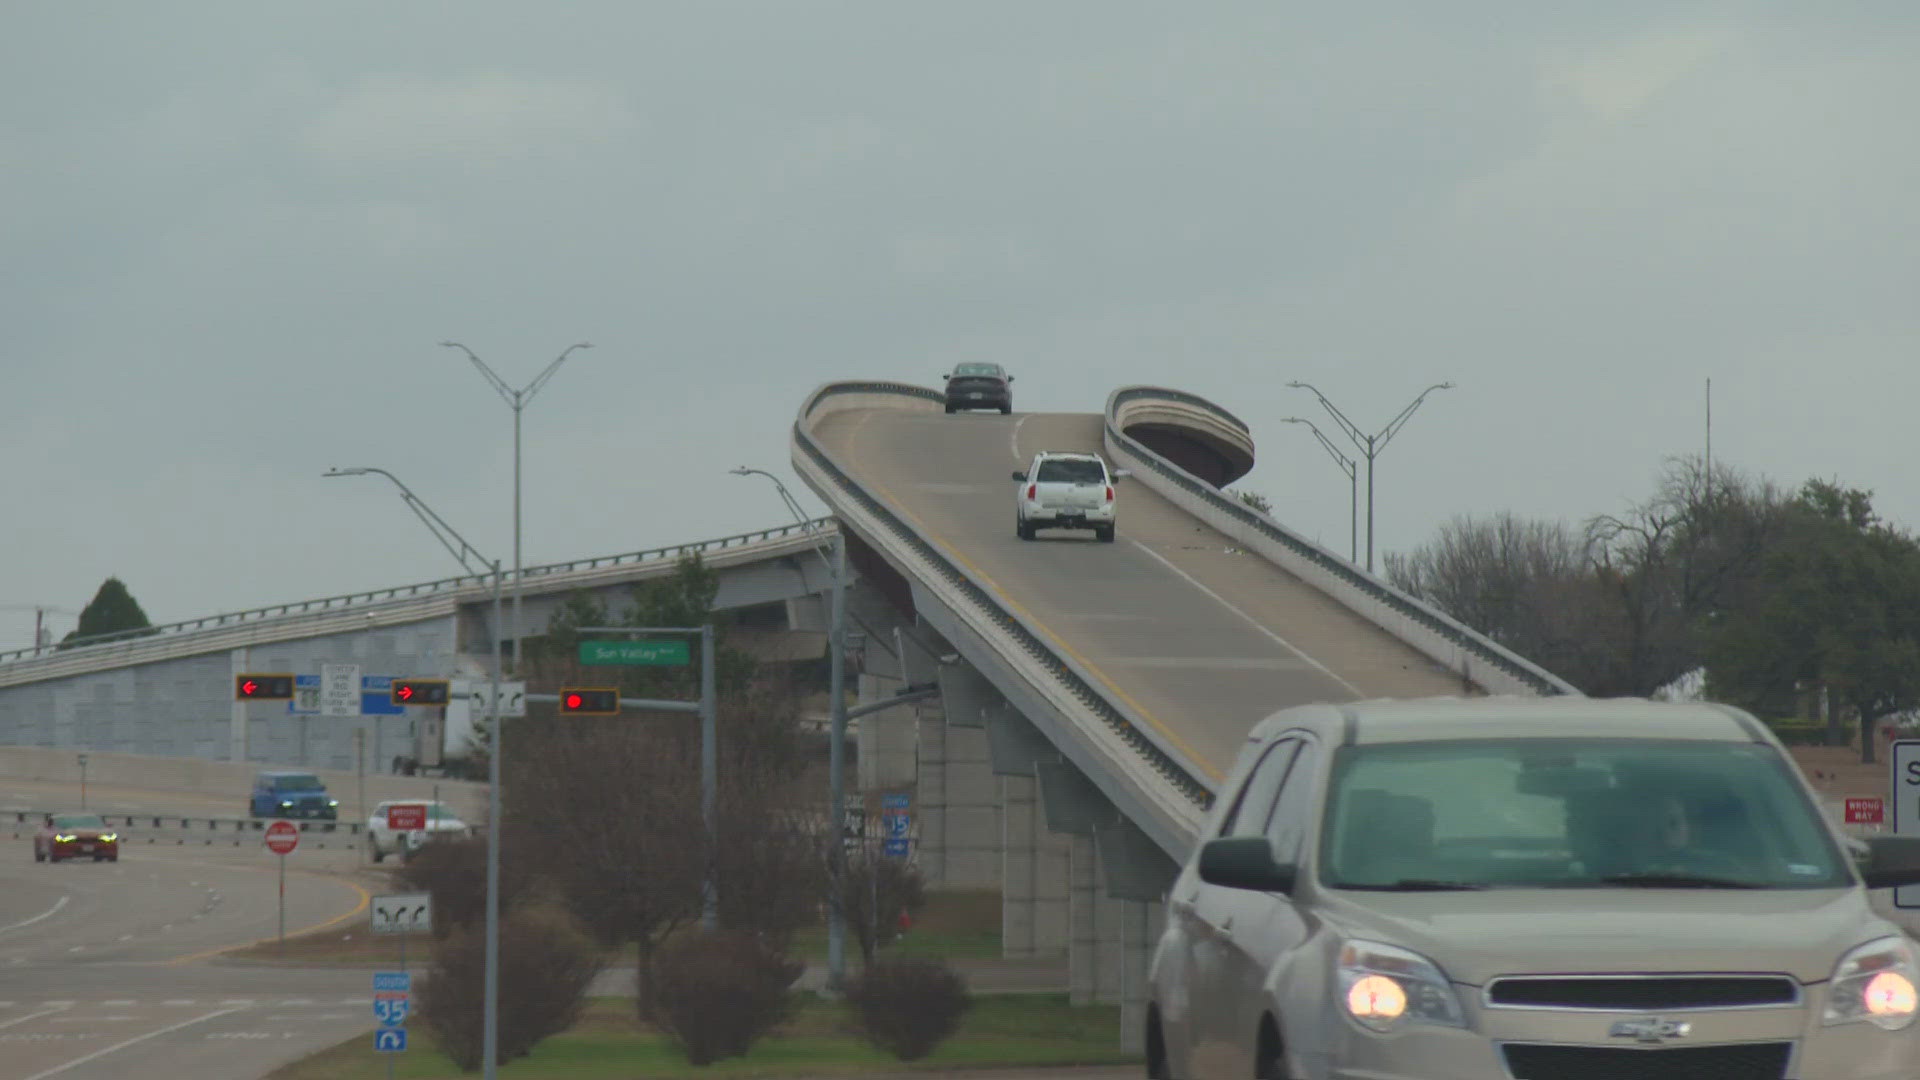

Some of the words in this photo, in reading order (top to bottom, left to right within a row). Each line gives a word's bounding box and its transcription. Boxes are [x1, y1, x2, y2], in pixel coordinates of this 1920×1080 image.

[595, 647, 617, 659] Sun
[620, 647, 657, 661] Valley
[1849, 801, 1880, 811] WRONG
[1854, 811, 1873, 820] WAY
[377, 1001, 406, 1021] 35
